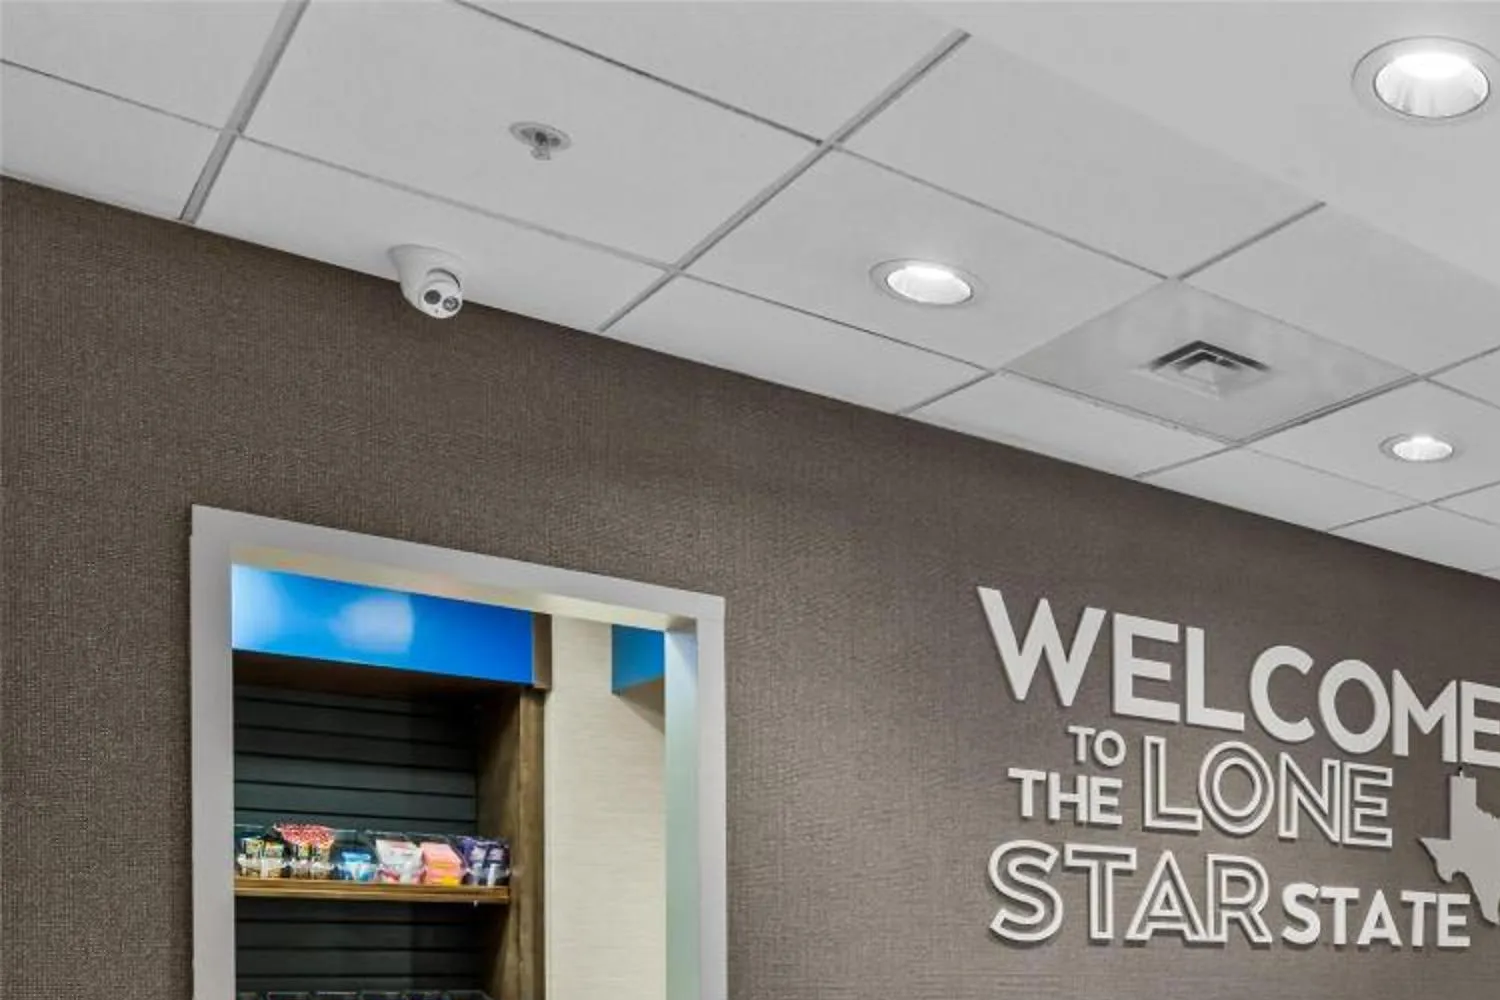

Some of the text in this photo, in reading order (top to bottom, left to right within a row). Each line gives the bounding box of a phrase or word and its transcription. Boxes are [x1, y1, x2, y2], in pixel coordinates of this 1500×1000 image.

[1007, 735, 1394, 849] THE LONE
[1067, 724, 1127, 768] TO
[987, 839, 1472, 948] STAR STATE
